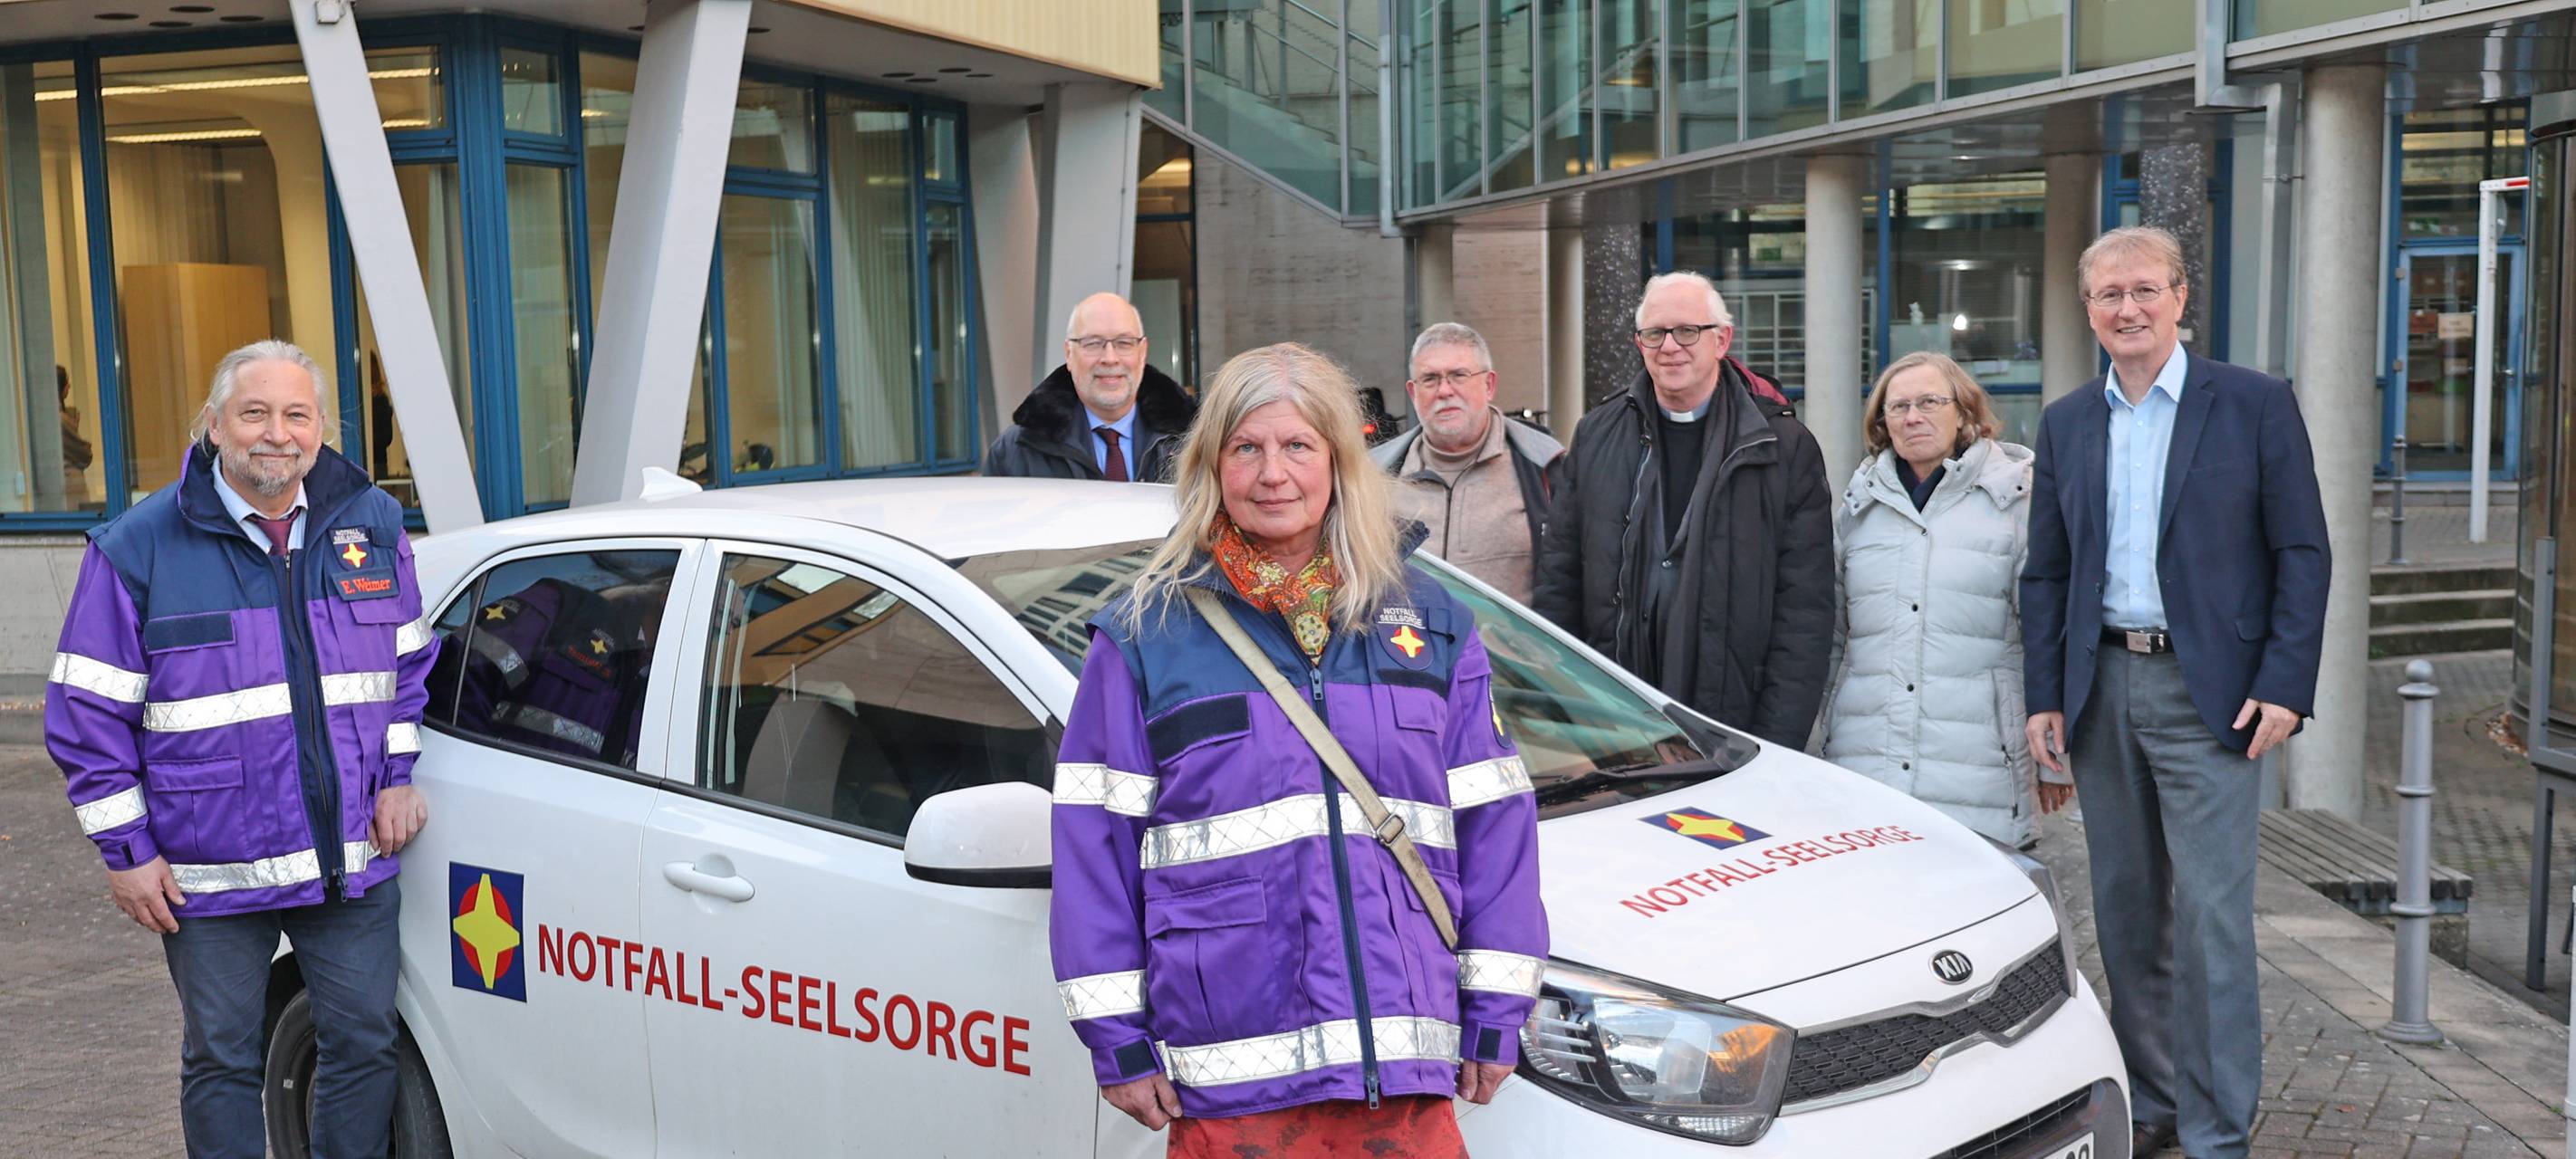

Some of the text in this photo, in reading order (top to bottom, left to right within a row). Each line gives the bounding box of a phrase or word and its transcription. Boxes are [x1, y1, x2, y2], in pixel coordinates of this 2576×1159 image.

[1379, 614, 1423, 627] SEELSORGE
[1383, 608, 1417, 618] NOTFALL
[1619, 825, 1926, 918] NOTFALL-SEELSORGE
[1934, 953, 1972, 979] KIA
[538, 924, 1031, 1076] NOTFALL-SEELSORGE
